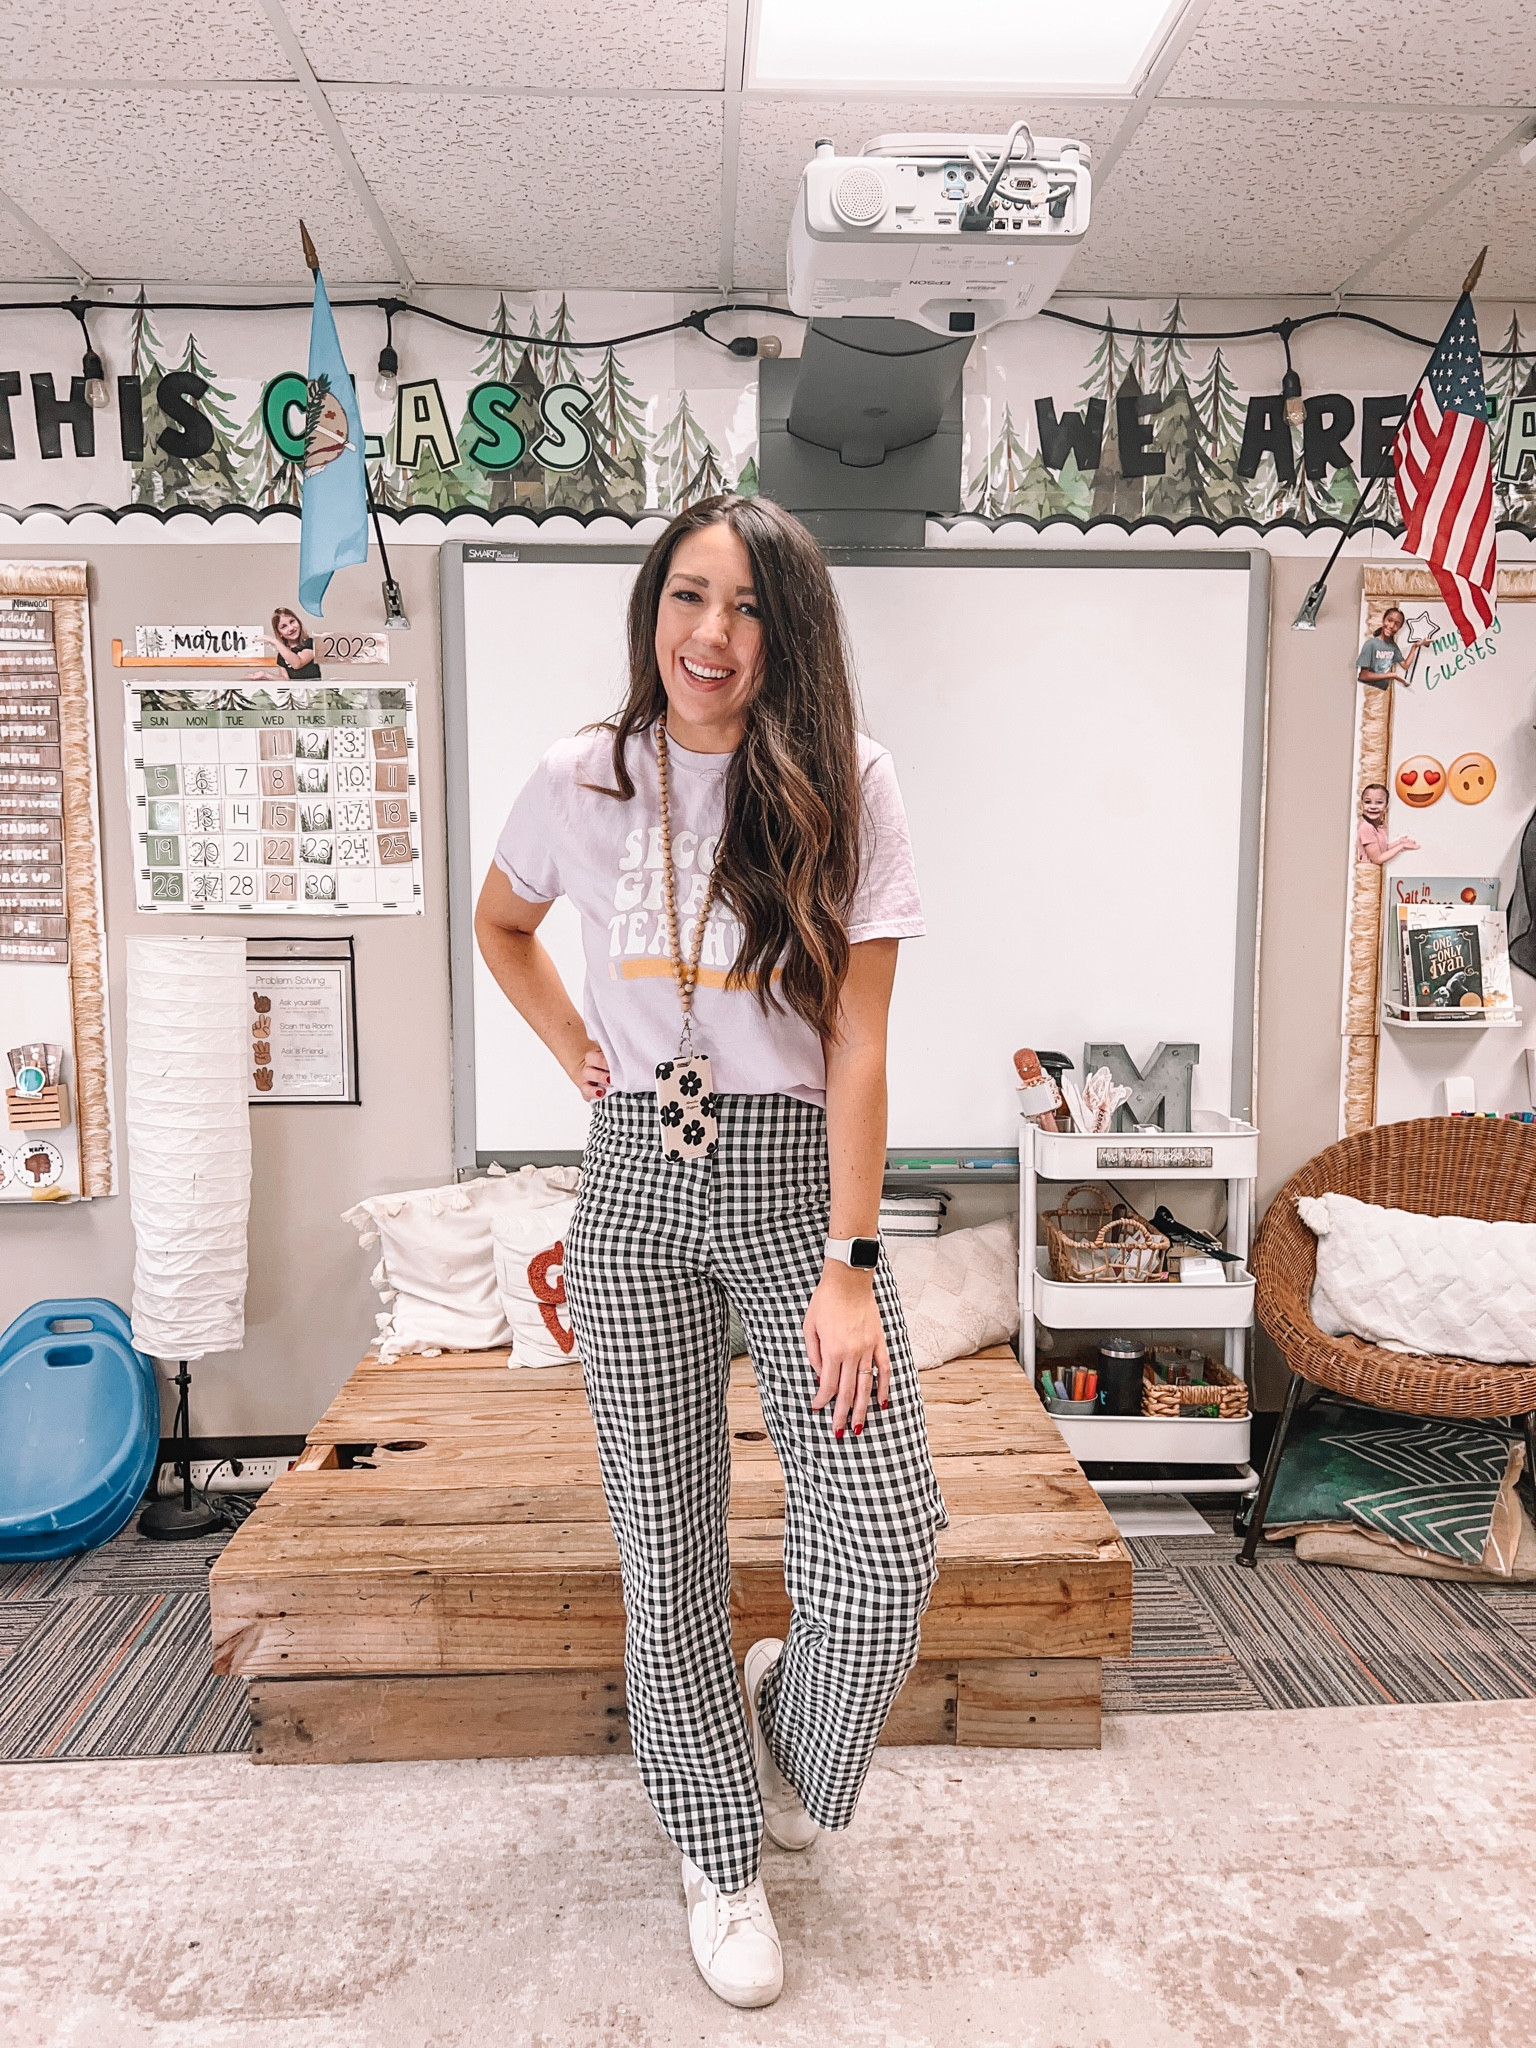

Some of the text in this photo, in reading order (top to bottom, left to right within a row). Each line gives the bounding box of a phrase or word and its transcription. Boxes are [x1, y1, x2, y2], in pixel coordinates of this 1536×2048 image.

[262, 372, 597, 472] CASS
[1035, 394, 1167, 478] WE
[1238, 393, 1407, 479] ARE
[173, 630, 247, 654] March
[323, 636, 377, 659] 2023
[1425, 637, 1497, 691] Guests
[150, 714, 396, 726] SUN MON TUE WED THURS FRI SAT
[307, 732, 319, 753] 2
[343, 732, 356, 753] 3
[381, 730, 398, 752] 4
[0, 752, 40, 765] MATH
[19, 775, 57, 786] ALOUD
[154, 765, 397, 790] 5 6 7 8 9 10 11
[196, 807, 214, 828] 13
[232, 803, 249, 825] 14
[271, 805, 288, 827] 15
[307, 803, 325, 825] 16
[345, 803, 362, 824] 17
[383, 802, 401, 823] 18
[154, 835, 407, 863] 19 20 21 22 23 24 25
[619, 826, 724, 875] SECO
[31, 872, 51, 884] UP
[153, 873, 334, 897] 26 27 28 29 30
[1396, 880, 1431, 905] Salt in
[14, 920, 42, 935] P.E.
[0, 944, 56, 957] DISMISSAL
[1433, 936, 1453, 951] ONE
[1437, 944, 1462, 963] ONLY
[1430, 955, 1466, 980] Ivan
[255, 976, 326, 987] Problem Solving
[293, 999, 322, 1008] yourself
[279, 1022, 298, 1030] Scan
[312, 1022, 334, 1030] Room
[1084, 1042, 1200, 1132] M
